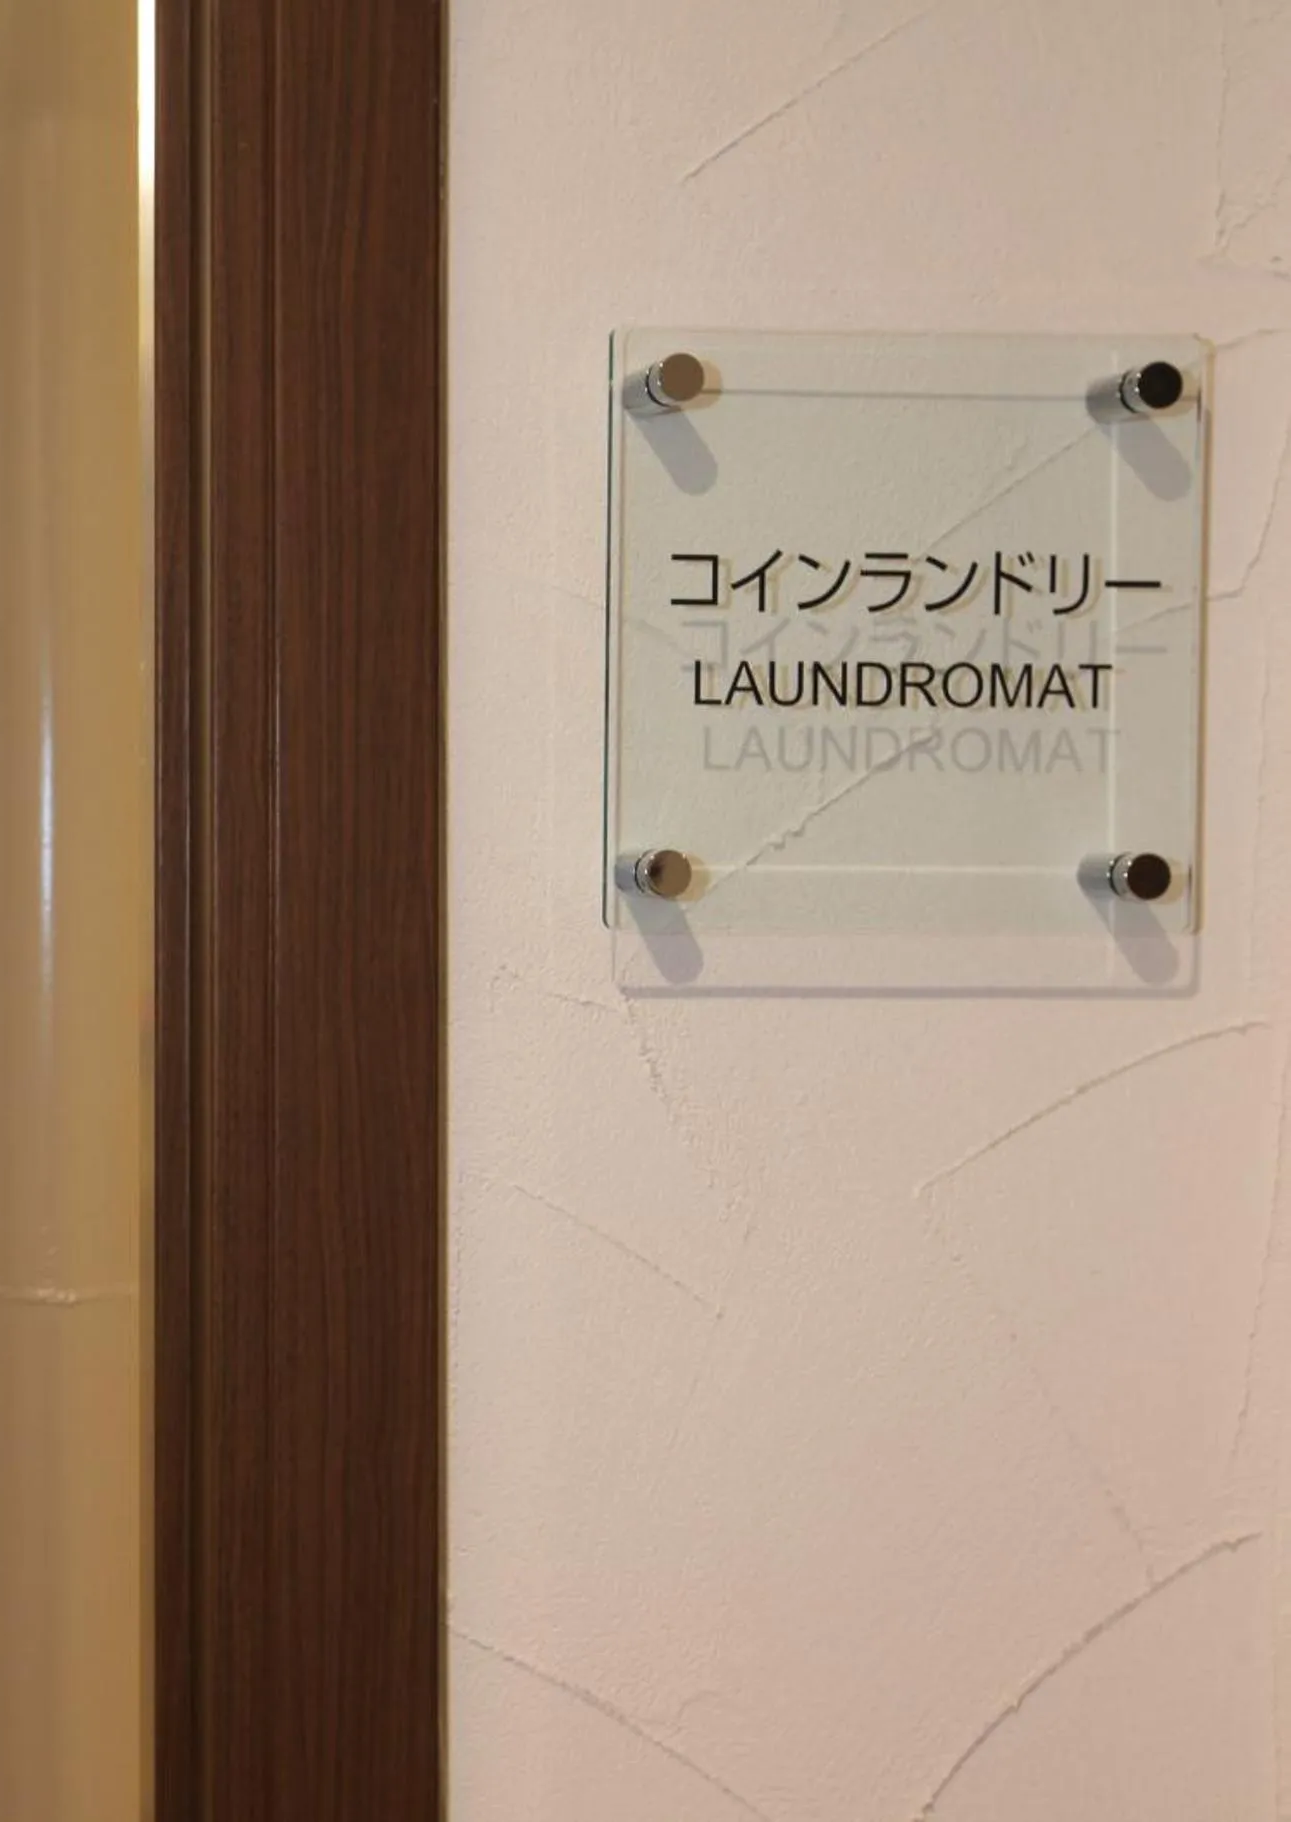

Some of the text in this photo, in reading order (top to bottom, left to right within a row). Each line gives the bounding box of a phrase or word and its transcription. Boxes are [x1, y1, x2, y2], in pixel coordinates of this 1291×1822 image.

[670, 549, 1162, 616] コインランドリー
[693, 659, 1113, 709] LAUNDROMAT
